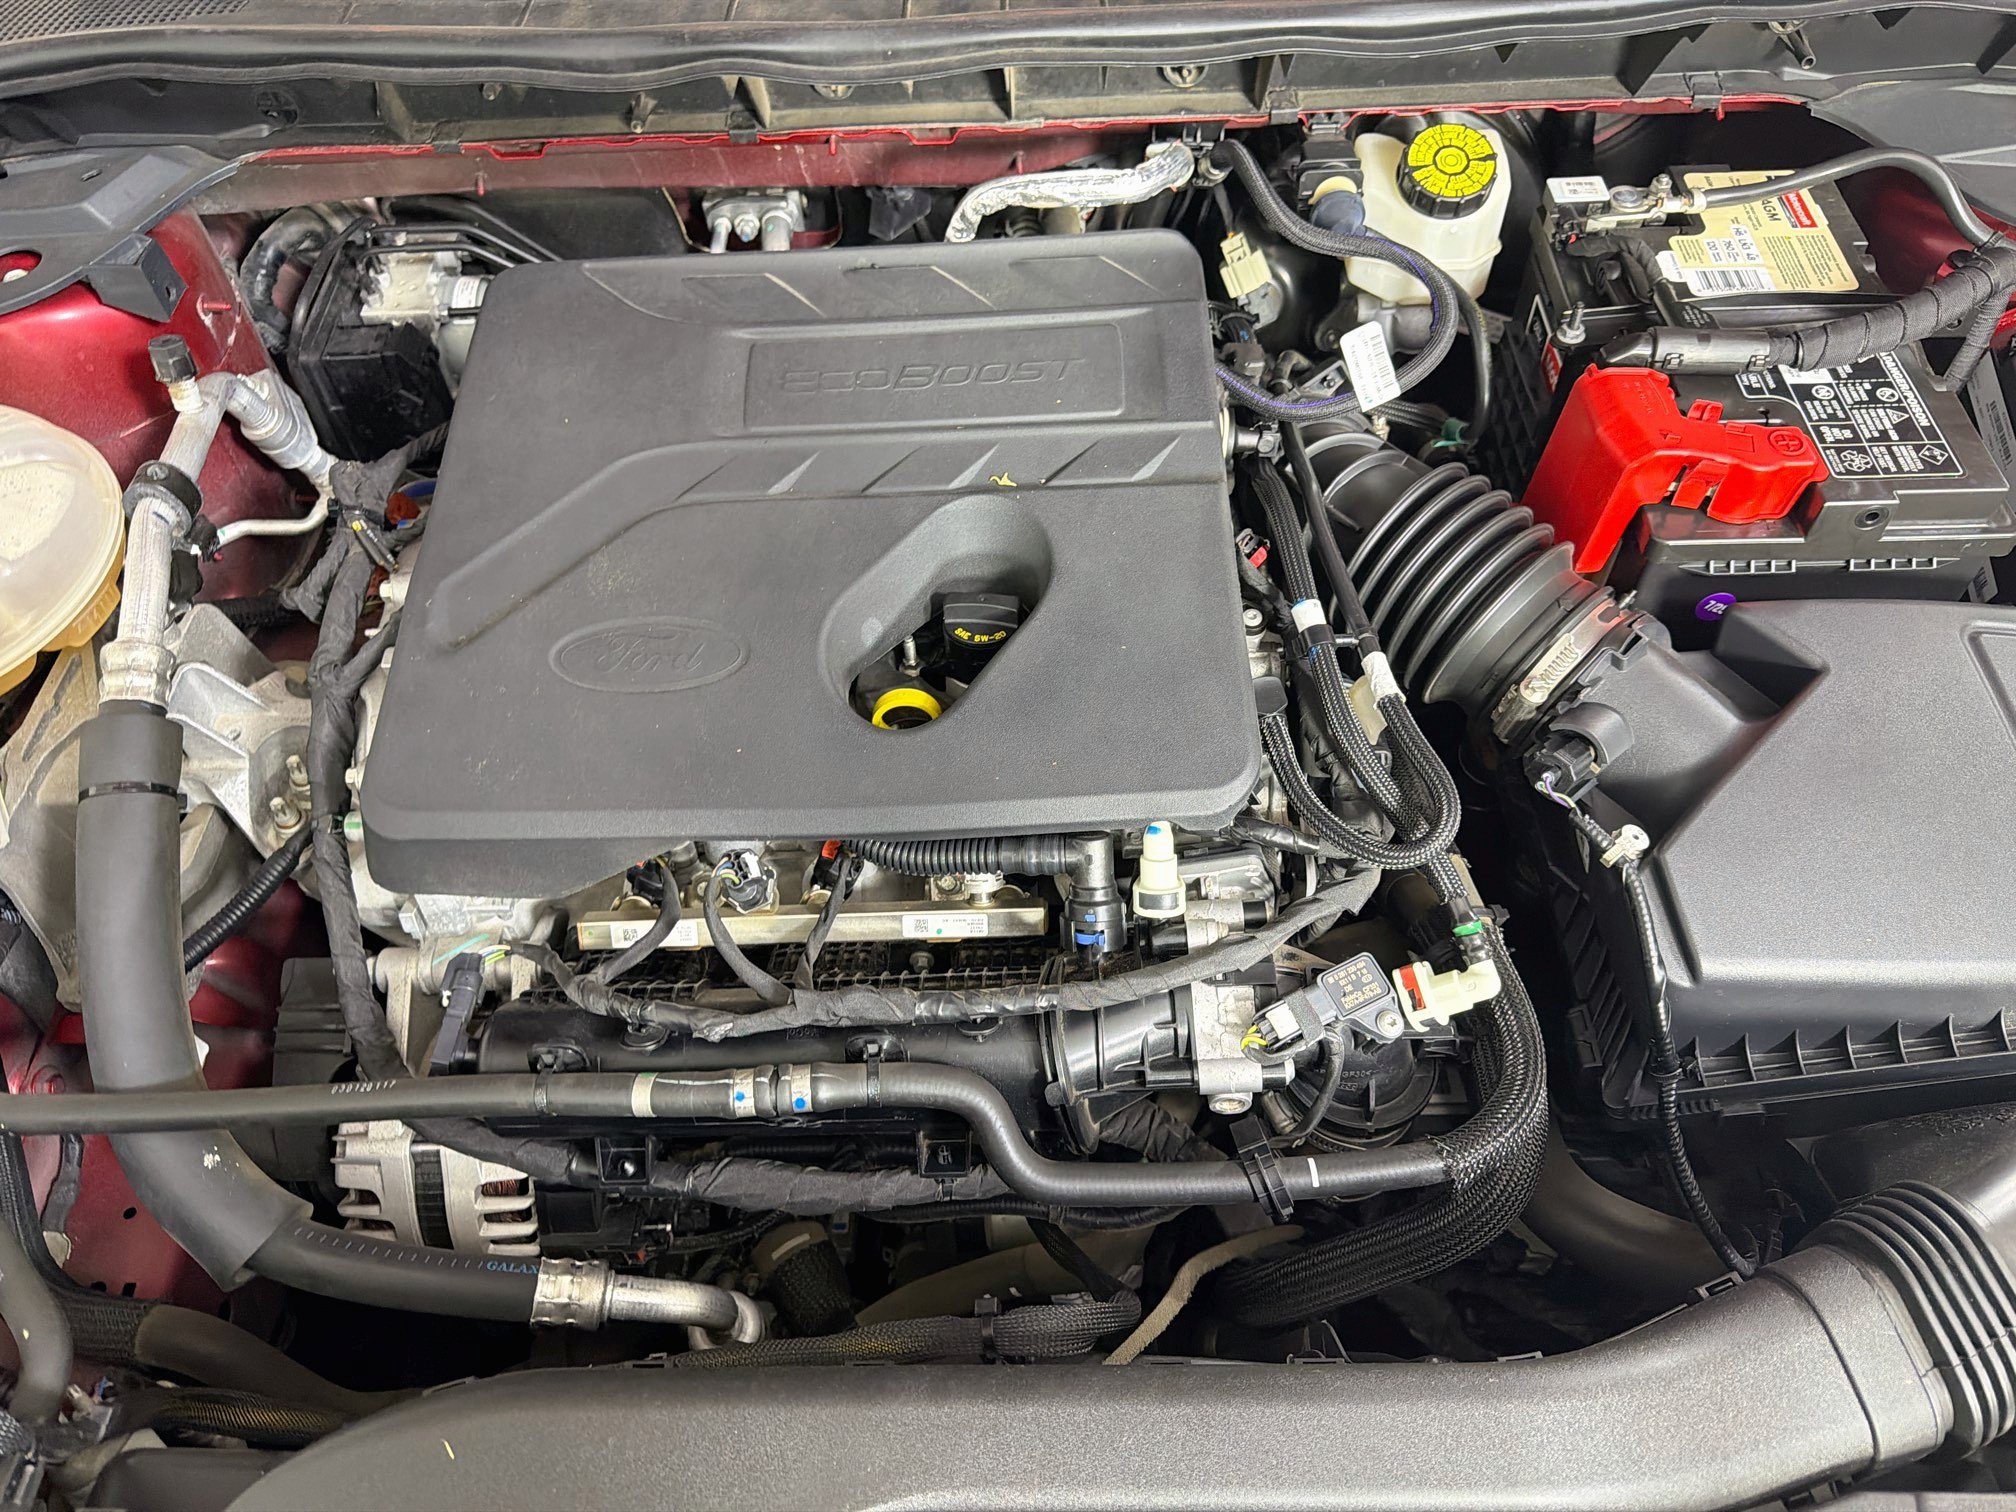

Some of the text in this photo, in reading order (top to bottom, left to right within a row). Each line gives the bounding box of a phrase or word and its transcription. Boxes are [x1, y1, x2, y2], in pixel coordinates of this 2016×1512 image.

[1788, 192, 1812, 226] Motorcraft
[1882, 356, 1929, 426] DANGER/POISON
[1819, 426, 1835, 443] OPEN.
[1830, 427, 1844, 440] NOT
[1841, 429, 1853, 438] DO
[954, 627, 1006, 642] SAE 5W-20
[598, 632, 706, 673] Ford
